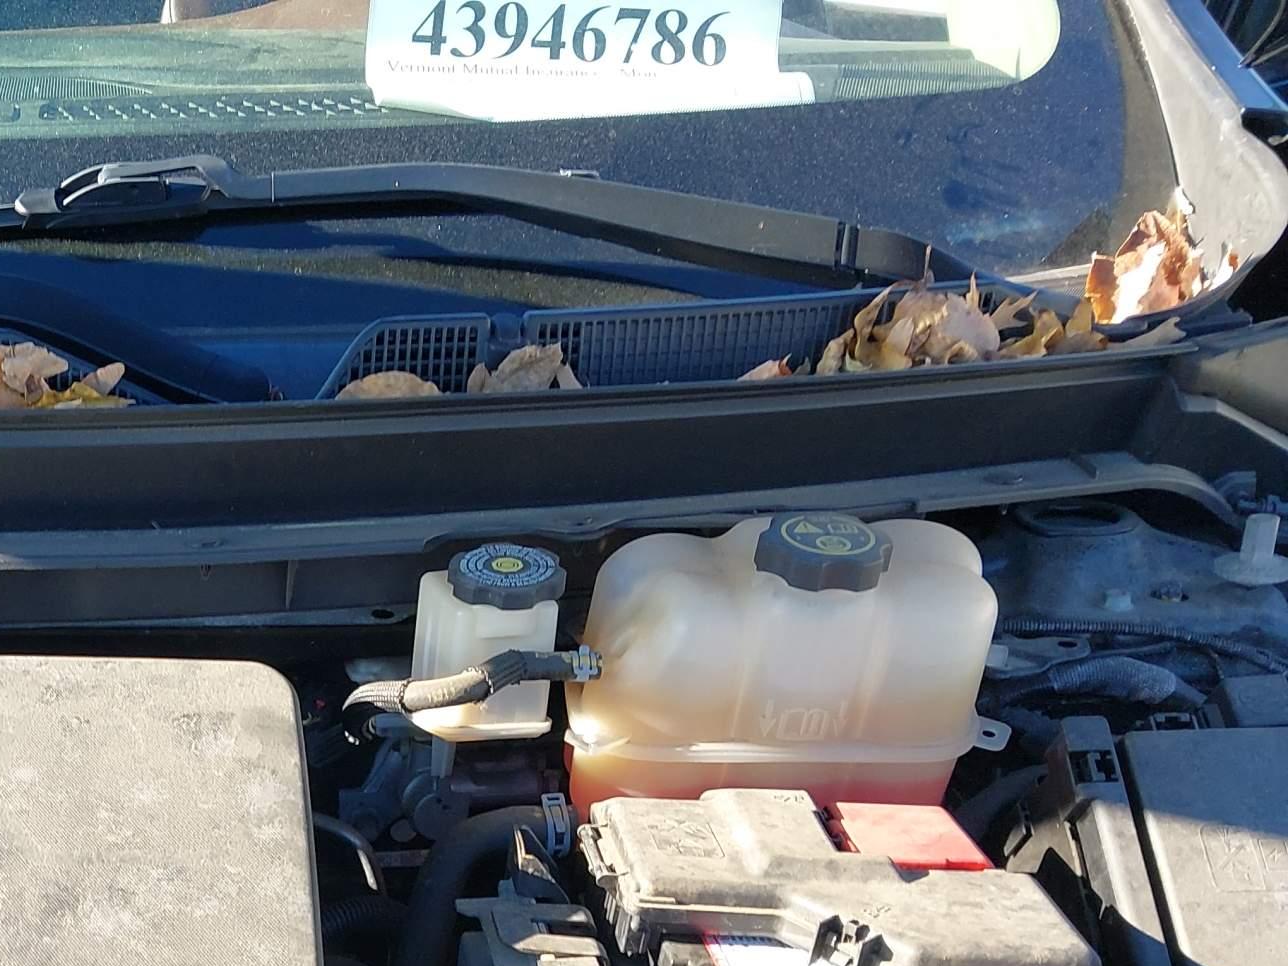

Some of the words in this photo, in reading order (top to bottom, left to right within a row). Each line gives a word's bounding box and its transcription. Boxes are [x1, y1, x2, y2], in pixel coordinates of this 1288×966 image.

[411, 0, 731, 66] 43946786
[386, 60, 456, 74] Vermont
[462, 63, 519, 77] Mutual
